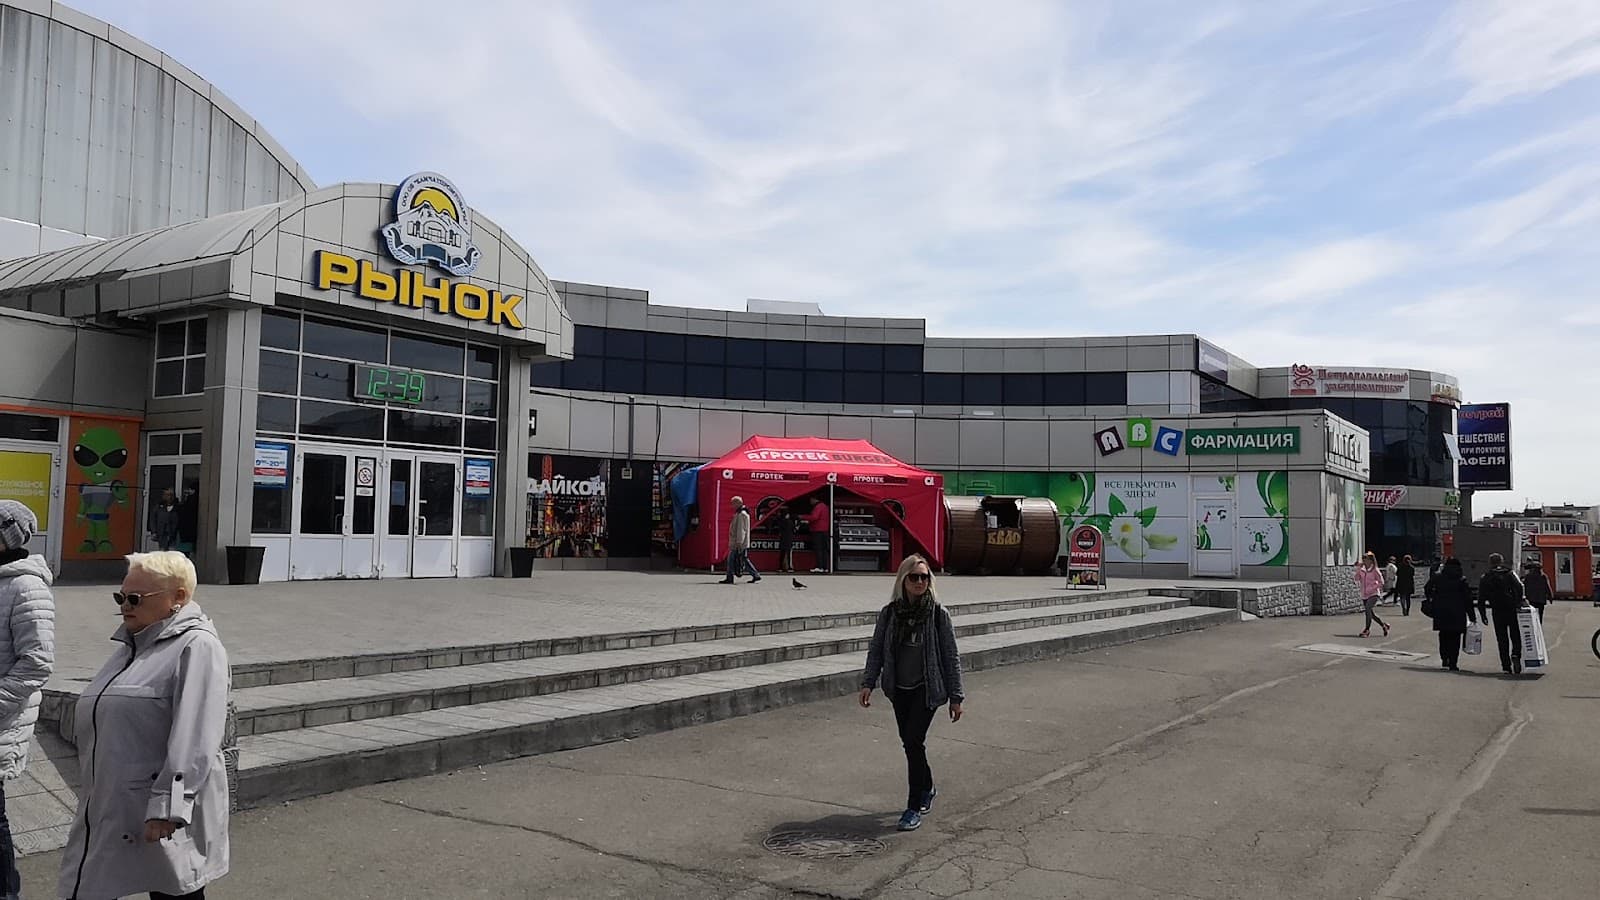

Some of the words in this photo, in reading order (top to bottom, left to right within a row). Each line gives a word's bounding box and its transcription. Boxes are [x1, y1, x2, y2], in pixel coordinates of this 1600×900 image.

[318, 250, 524, 329] РЫНОК
[368, 368, 424, 402] 12:39
[1191, 433, 1294, 449] ФАРМАЦИЯ
[747, 450, 829, 461] АГРОТЕК
[1458, 456, 1505, 465] АФЕЛЯ
[751, 472, 784, 480] АГРОТЕК
[853, 475, 885, 483] АГРОТЕК
